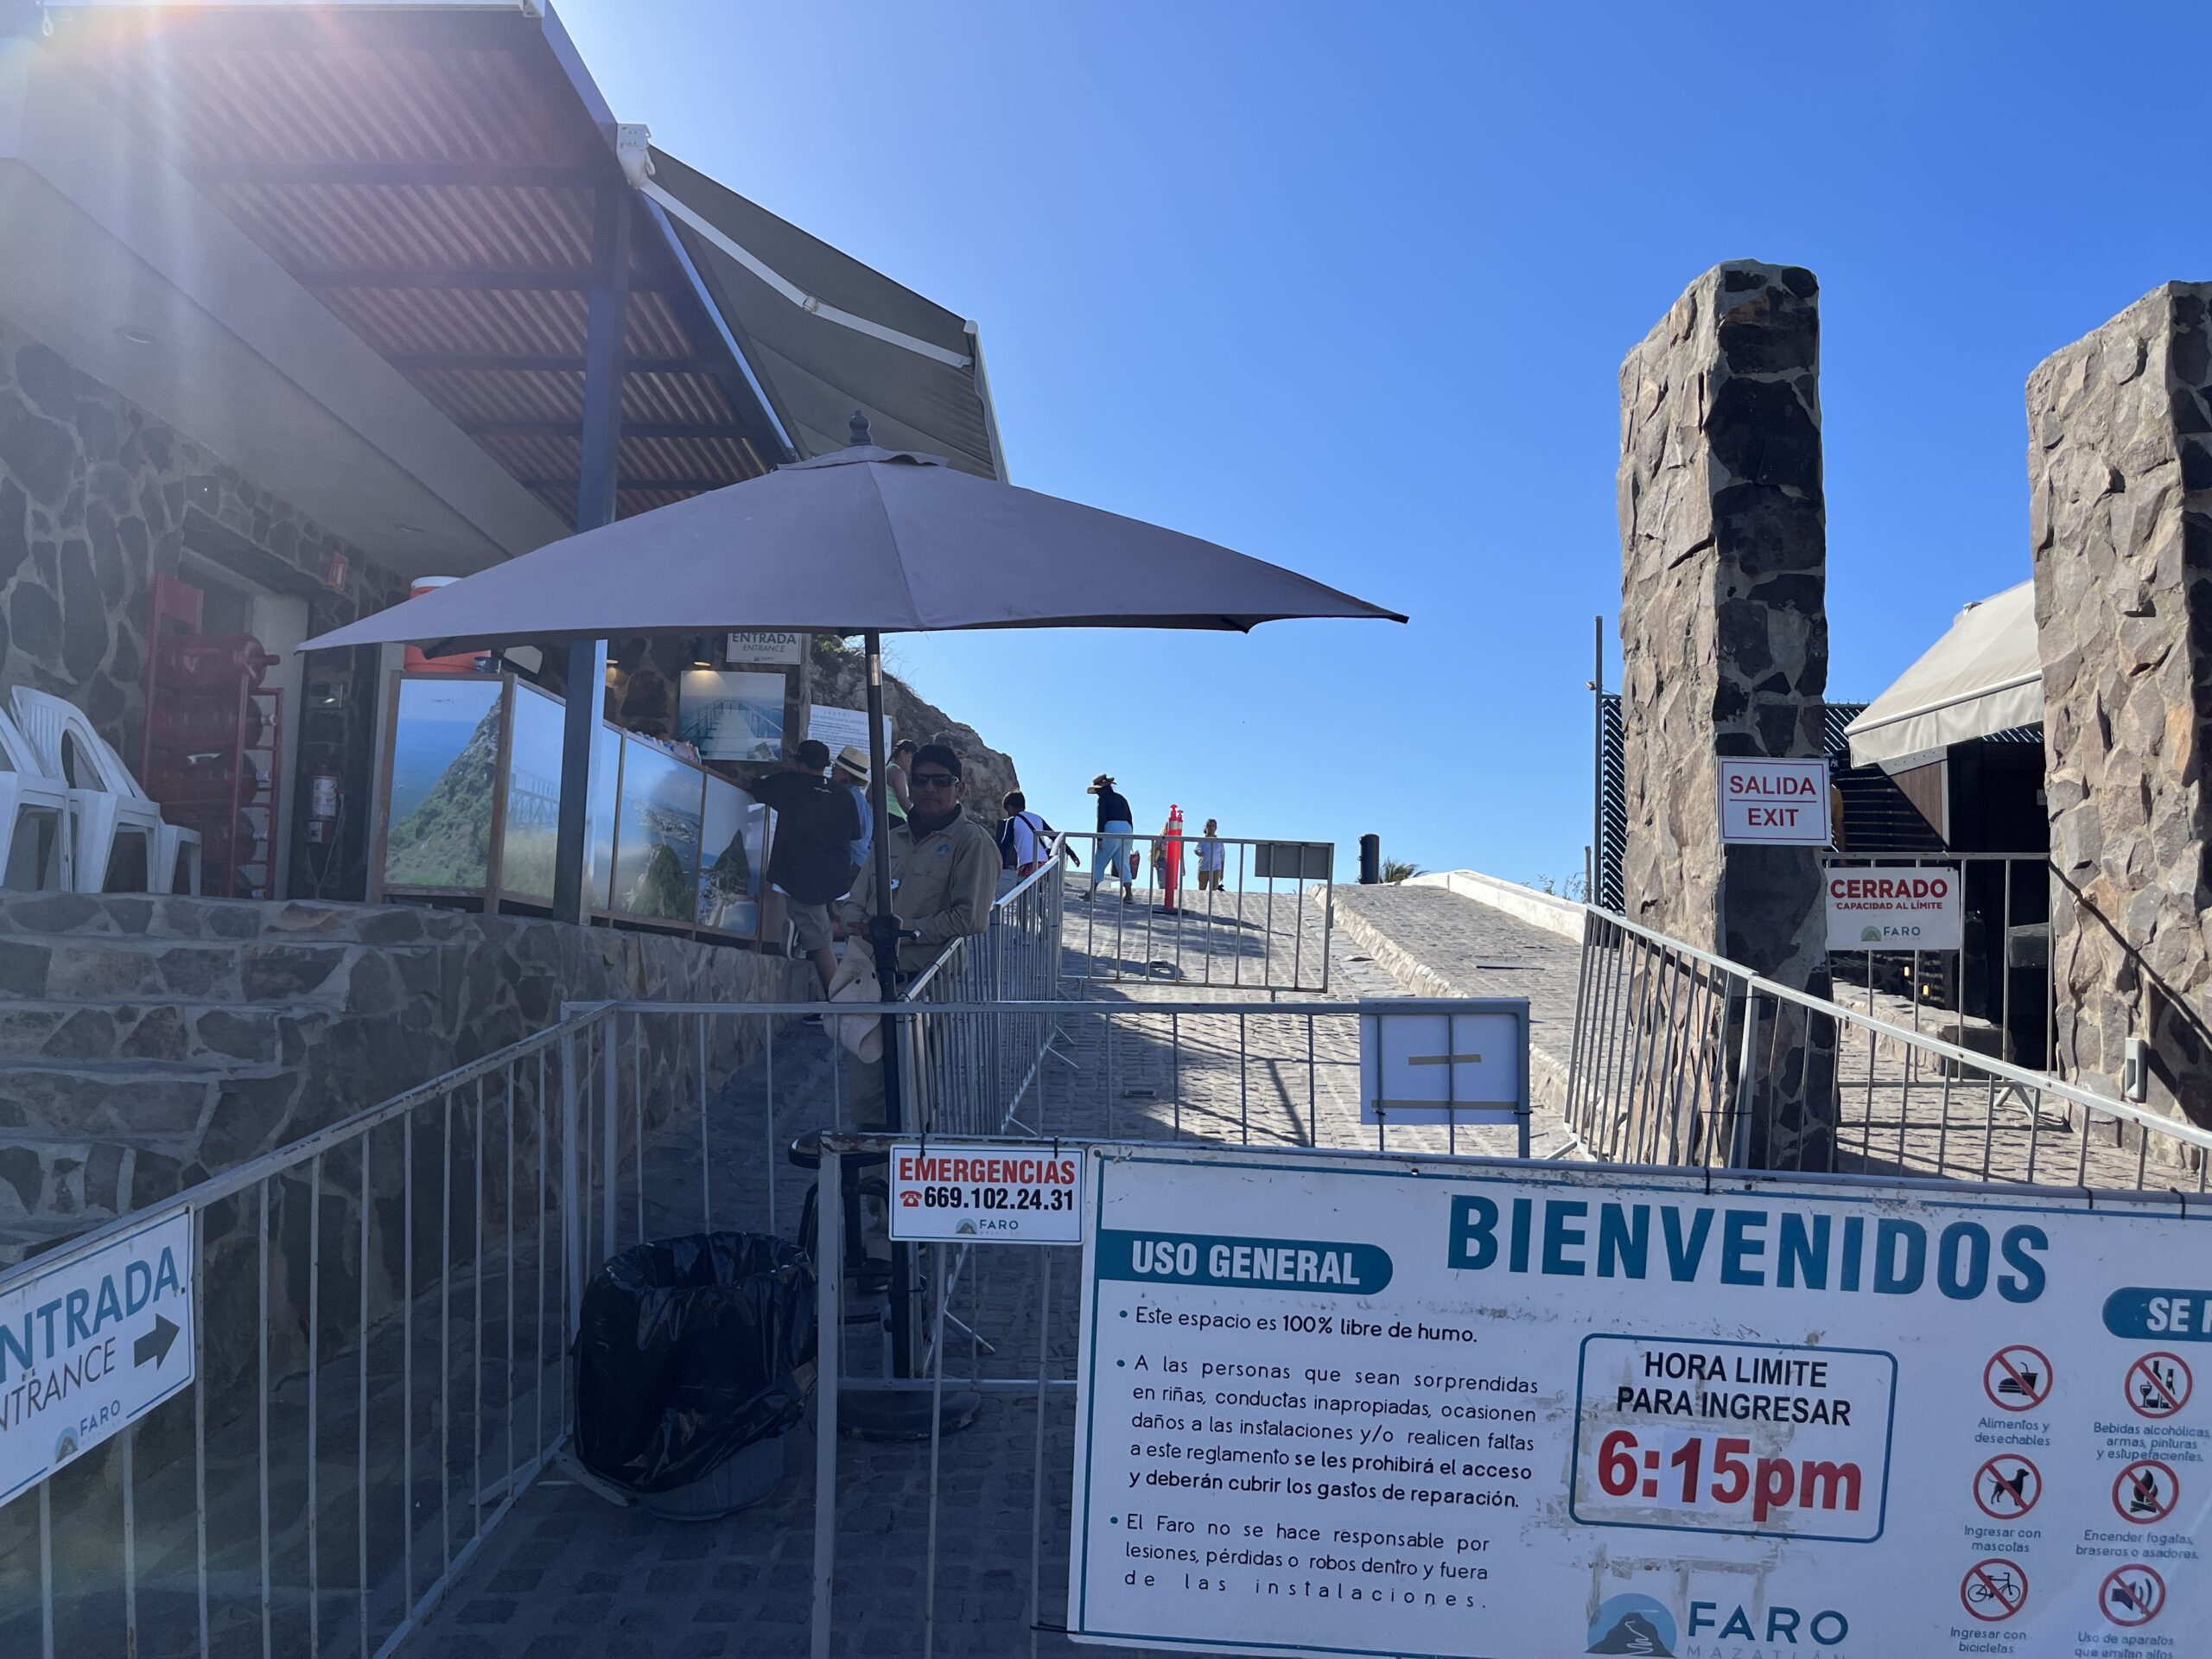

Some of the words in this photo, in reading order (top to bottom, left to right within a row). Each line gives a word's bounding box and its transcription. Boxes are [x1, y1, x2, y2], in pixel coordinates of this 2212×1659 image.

[732, 632, 796, 645] ENTRADA
[742, 644, 785, 652] ENTRANCE
[1729, 775, 1816, 795] SALIDA
[1747, 808, 1799, 827] EXIT
[1830, 879, 1948, 899] CERRADO
[1910, 899, 1943, 910] LÍMITE
[1884, 926, 1921, 936] FARO
[899, 1157, 1076, 1185] EMERGENCIAS
[924, 1186, 1073, 1211] 669.102.24.31
[979, 1219, 1019, 1230] FARO
[1446, 1194, 2050, 1303] BIENVENIDOS
[1131, 1240, 1197, 1277] USO
[1208, 1245, 1360, 1286] GENERAL
[0, 1245, 180, 1384] NTRADA
[1135, 1306, 1173, 1325] Este
[1178, 1313, 1251, 1332] espacio
[1256, 1318, 1277, 1332] es
[1282, 1314, 1333, 1334] 100%
[1340, 1318, 1382, 1337] libre
[1388, 1321, 1413, 1338] de
[1417, 1322, 1478, 1343] humo.
[2146, 1297, 2191, 1332] SE
[1134, 1354, 1149, 1371] A
[1163, 1355, 1188, 1374] las
[1201, 1362, 1291, 1380] personas
[1304, 1368, 1341, 1385] que
[1355, 1371, 1400, 1386] sean
[1414, 1375, 1538, 1394] sorprendidas
[1645, 1351, 1727, 1382] HORA
[1735, 1357, 1827, 1388] LIMITE
[1133, 1387, 1155, 1401] en
[1162, 1386, 1206, 1406] riñas,
[1215, 1389, 1306, 1409] conductas
[1313, 1398, 1432, 1419] inapropiadas,
[1440, 1405, 1536, 1423] ocasionen
[1617, 1386, 1693, 1416] PARA
[1700, 1392, 1851, 1426] INGRESAR
[79, 1400, 121, 1437] FARO
[1977, 1416, 2039, 1431] Alimentos
[2041, 1422, 2050, 1434] y
[2093, 1421, 2140, 1435] Bebidas
[1131, 1411, 1185, 1431] daños
[1191, 1419, 1203, 1432] a
[1209, 1415, 1233, 1433] las
[1240, 1419, 1353, 1440] instalaciones
[1359, 1424, 1394, 1446] y/o
[1408, 1429, 1480, 1448] realicen
[1487, 1432, 1535, 1452] faltas
[1974, 1432, 2050, 1446] desechables
[2106, 1438, 2146, 1449] armas,
[2151, 1438, 2198, 1451] pinturas
[1130, 1444, 1141, 1456] a
[1146, 1441, 1182, 1459] este
[1186, 1445, 1290, 1465] reglamento
[1294, 1453, 1316, 1467] se
[1321, 1451, 1347, 1469] les
[1351, 1454, 1434, 1474] prohibirá
[1440, 1459, 1457, 1476] el
[1462, 1464, 1532, 1480] acceso
[2095, 1449, 2105, 1461] y
[2107, 1448, 2203, 1462] estupefacientes.
[1598, 1429, 1861, 1522] 6:15pm
[1128, 1471, 1141, 1489] y
[1146, 1469, 1224, 1490] deberán
[1228, 1475, 1281, 1493] cubrir
[1287, 1477, 1313, 1495] los
[1317, 1481, 1376, 1500] gastos
[1382, 1483, 1406, 1501] de
[1410, 1489, 1519, 1508] reparación.
[1127, 1513, 1143, 1530] El
[1156, 1515, 1195, 1534] Faro
[1207, 1522, 1230, 1535] no
[1243, 1525, 1263, 1538] se
[1276, 1522, 1321, 1541] hace
[1333, 1530, 1445, 1549] responsable
[1457, 1538, 1490, 1554] por
[1964, 1524, 2015, 1539] Ingresar
[2017, 1529, 2042, 1539] con
[2083, 1529, 2144, 1543] Encender
[1971, 1541, 2030, 1553] mascotas
[2075, 1543, 2128, 1557] braseros
[2130, 1548, 2139, 1558] o
[1126, 1541, 1199, 1564] lesiones,
[1205, 1548, 1283, 1567] pérdidas
[1287, 1555, 1299, 1568] o
[1309, 1554, 1357, 1572] robos
[1361, 1556, 1418, 1576] dentro
[1422, 1564, 1434, 1581] y
[1440, 1560, 1488, 1580] fuera
[1124, 1569, 1155, 1587] de
[1185, 1573, 1226, 1592] las
[1255, 1580, 1486, 1609] instalaciones.
[1688, 1601, 1849, 1645] FARO
[1949, 1626, 2001, 1641] Ingresar
[2003, 1630, 2027, 1641] con
[2078, 1630, 2100, 1643] Uso
[2102, 1632, 2119, 1644] de
[2121, 1635, 2174, 1647] aparatos
[1958, 1641, 2014, 1654] bicicletas
[2074, 1648, 2100, 1659] que
[2101, 1648, 2143, 1659] emitan
[2145, 1649, 2173, 1659] altos
